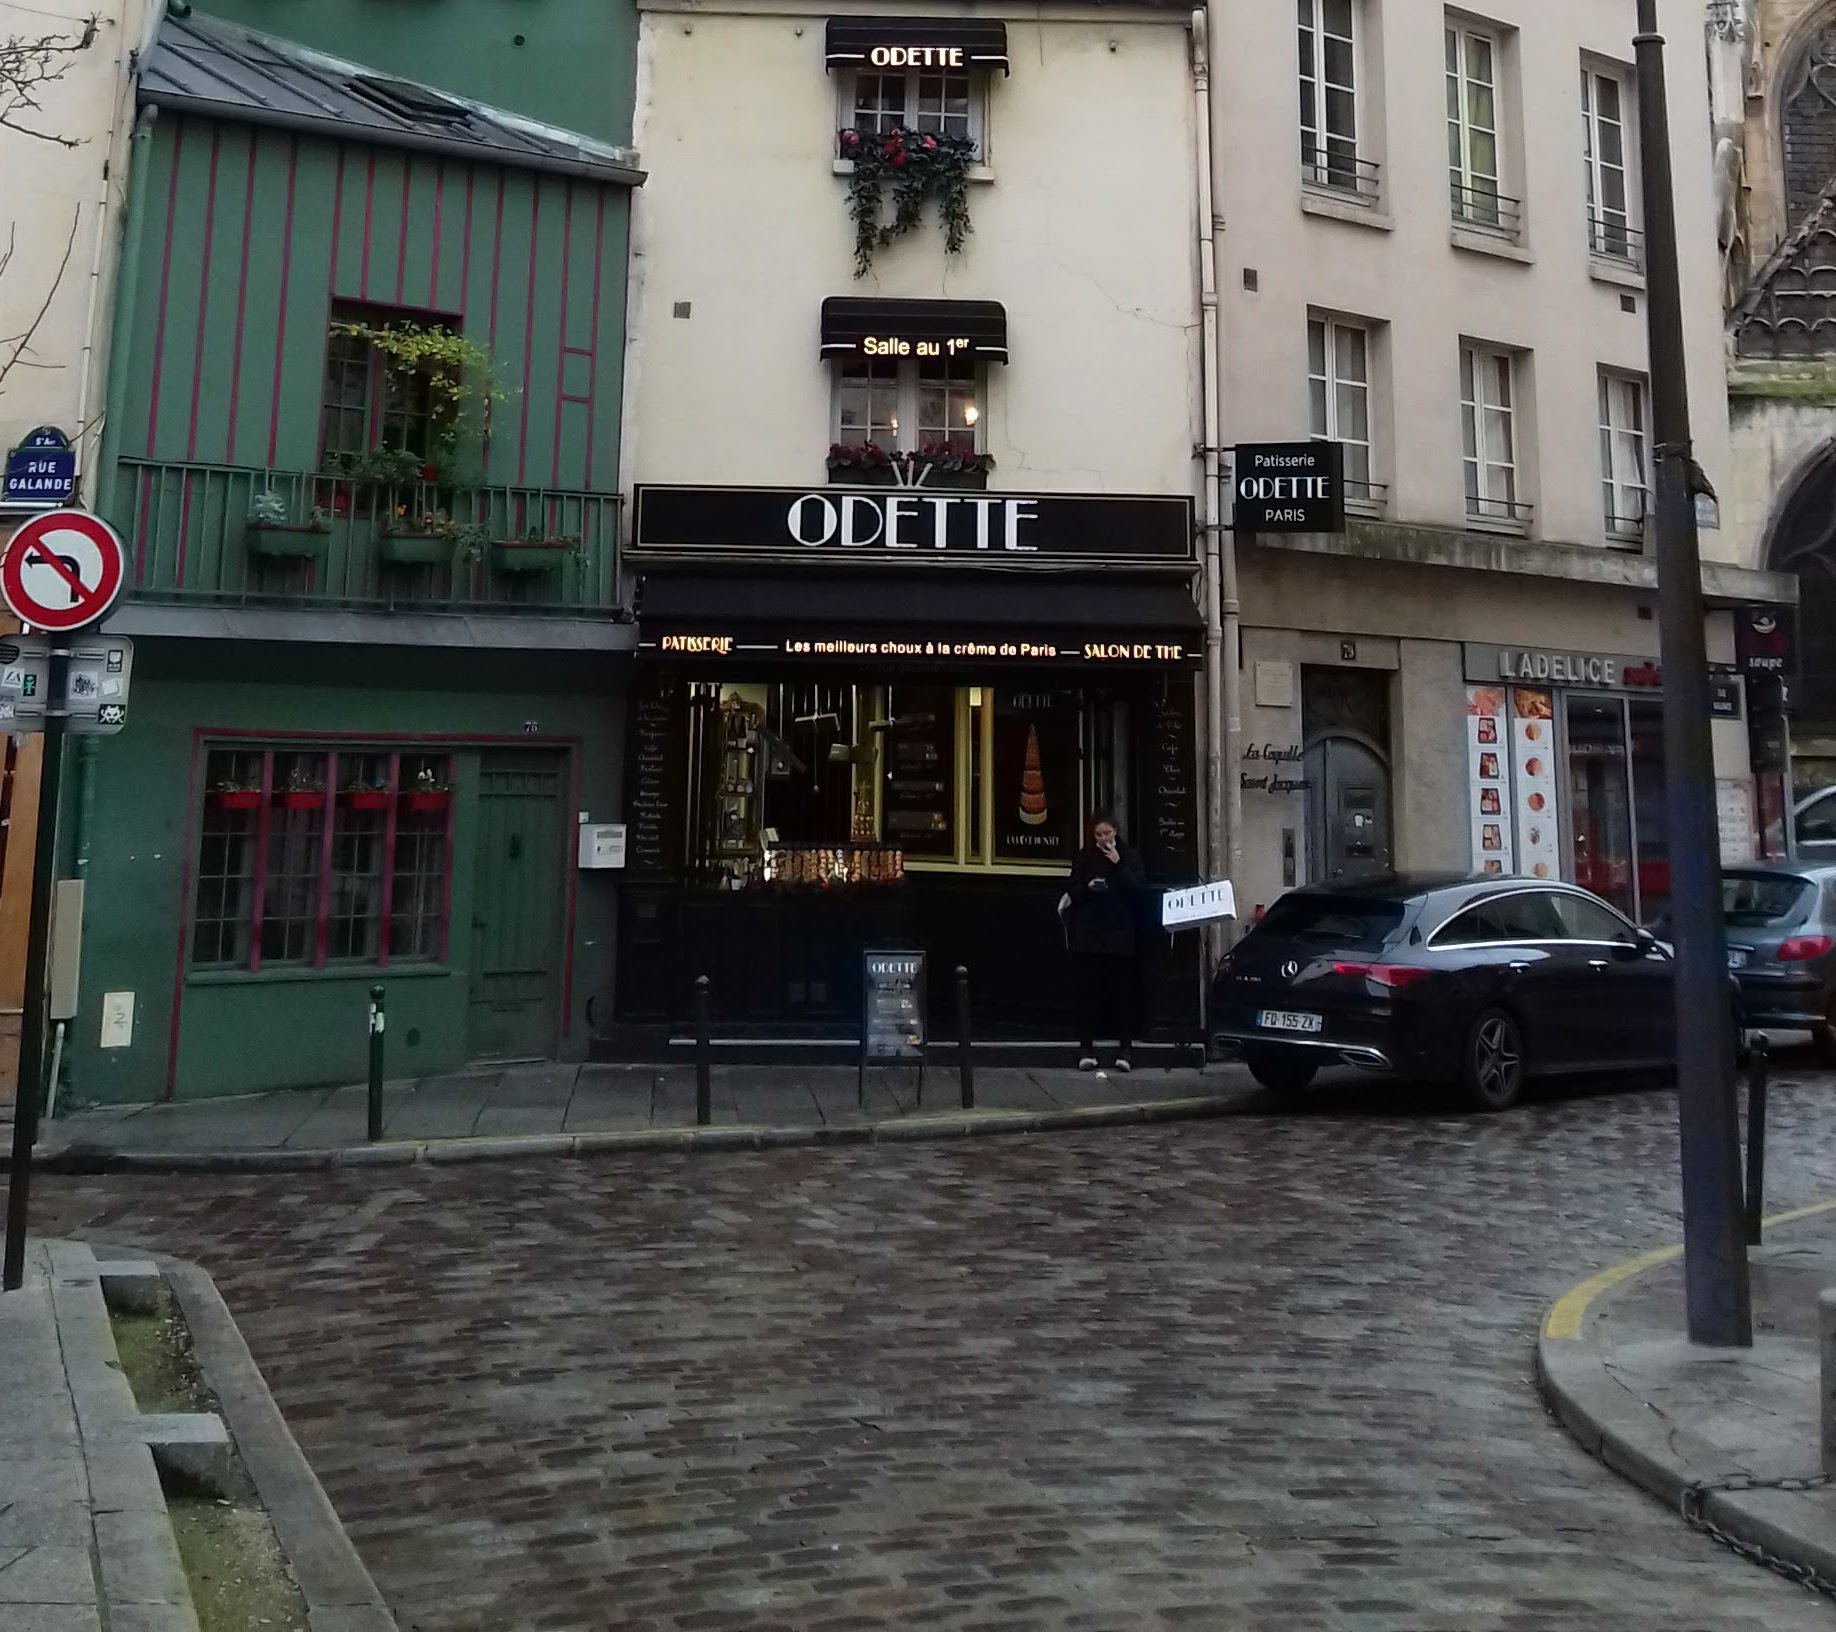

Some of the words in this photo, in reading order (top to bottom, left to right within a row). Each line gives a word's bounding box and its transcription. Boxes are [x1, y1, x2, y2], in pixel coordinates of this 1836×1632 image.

[870, 47, 964, 67] ODETTE
[863, 336, 910, 355] Salle
[916, 341, 940, 356] au
[946, 338, 970, 356] 1er
[28, 461, 57, 473] RUE
[1254, 453, 1315, 467] Patisserie
[9, 477, 72, 490] GALANDE
[1240, 476, 1331, 500] ODETTE
[787, 494, 1039, 551] ODETTE
[1265, 509, 1306, 522] PARIS
[662, 636, 734, 655] PATISSERIE
[785, 639, 811, 653] Les
[814, 639, 877, 654] meilleurs
[880, 641, 922, 654] choux
[937, 641, 950, 655] la
[1000, 643, 1017, 656] de
[1020, 643, 1057, 657] Paris
[1083, 643, 1130, 659] SALON
[1133, 644, 1153, 659] DE
[871, 962, 917, 974] ODETTE
